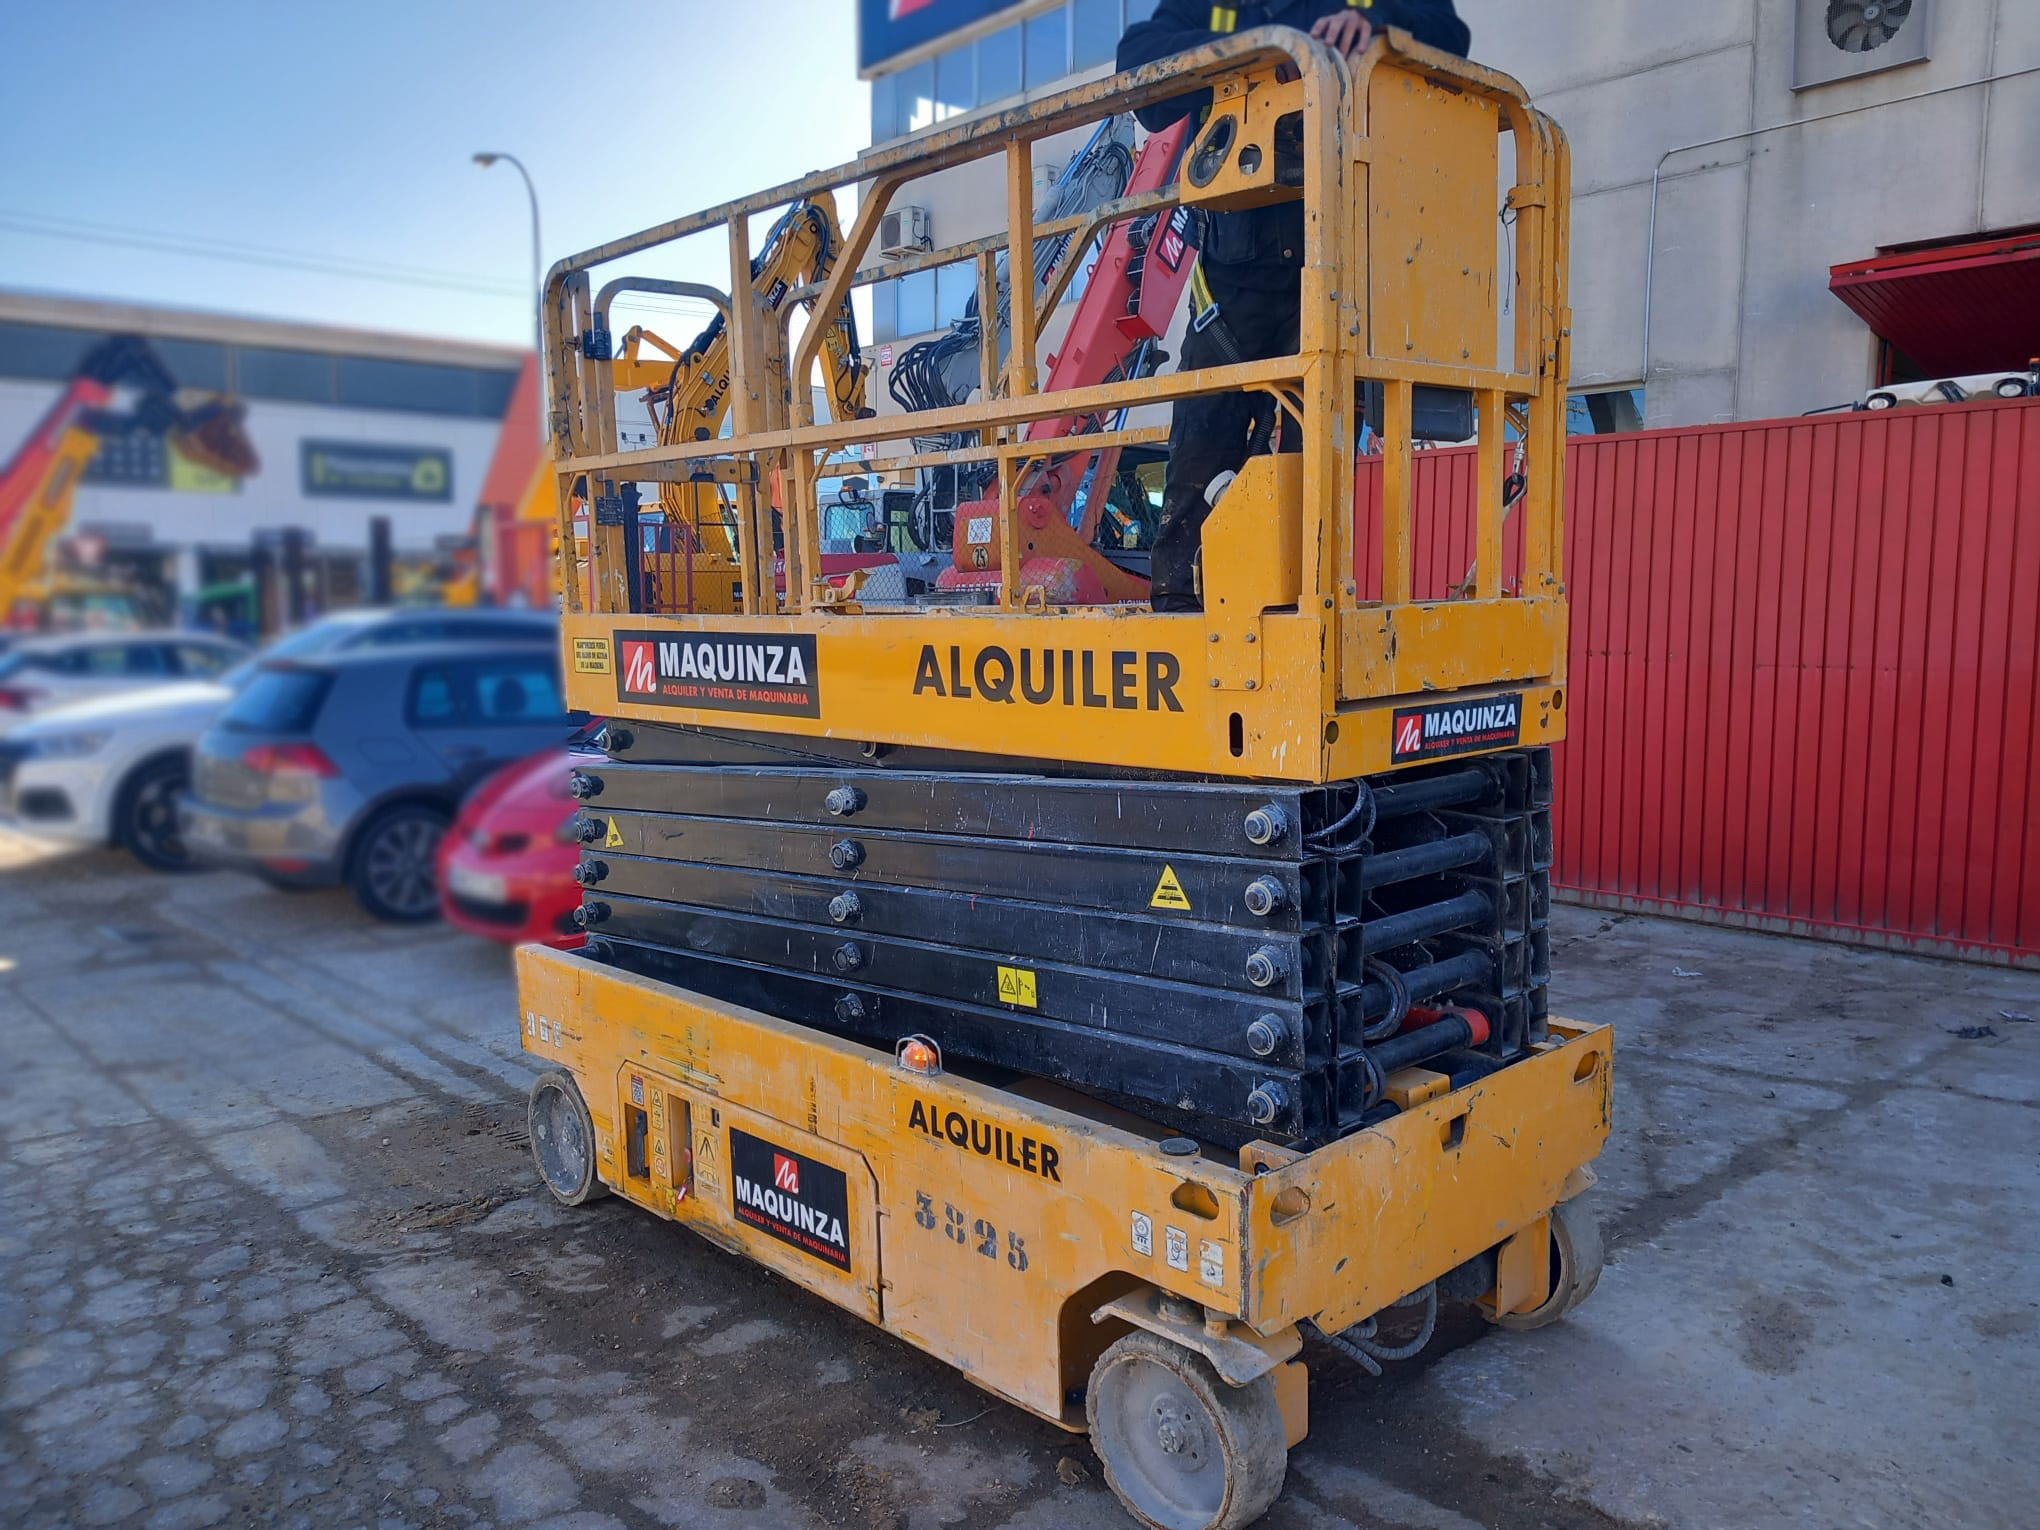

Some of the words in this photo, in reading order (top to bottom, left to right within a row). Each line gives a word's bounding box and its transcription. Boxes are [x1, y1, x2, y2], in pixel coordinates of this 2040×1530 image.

[659, 642, 808, 685] MAQUINZA
[662, 684, 698, 697] ALQUILER
[700, 687, 706, 697] Y
[708, 687, 734, 700] VENTA
[737, 691, 747, 701] DE
[749, 691, 809, 705] MAQUINARIA
[912, 644, 1185, 713] ALQUILER
[1424, 703, 1517, 738] MAQUINZA
[908, 1099, 1062, 1183] ALQUILER
[735, 1175, 845, 1248] MAQUINZA
[738, 1206, 765, 1226] ALQUILER
[772, 1219, 792, 1237] VENTA
[793, 1231, 801, 1242] DE
[803, 1236, 846, 1263] MAQUINARIA
[914, 1189, 1029, 1272] 3825
